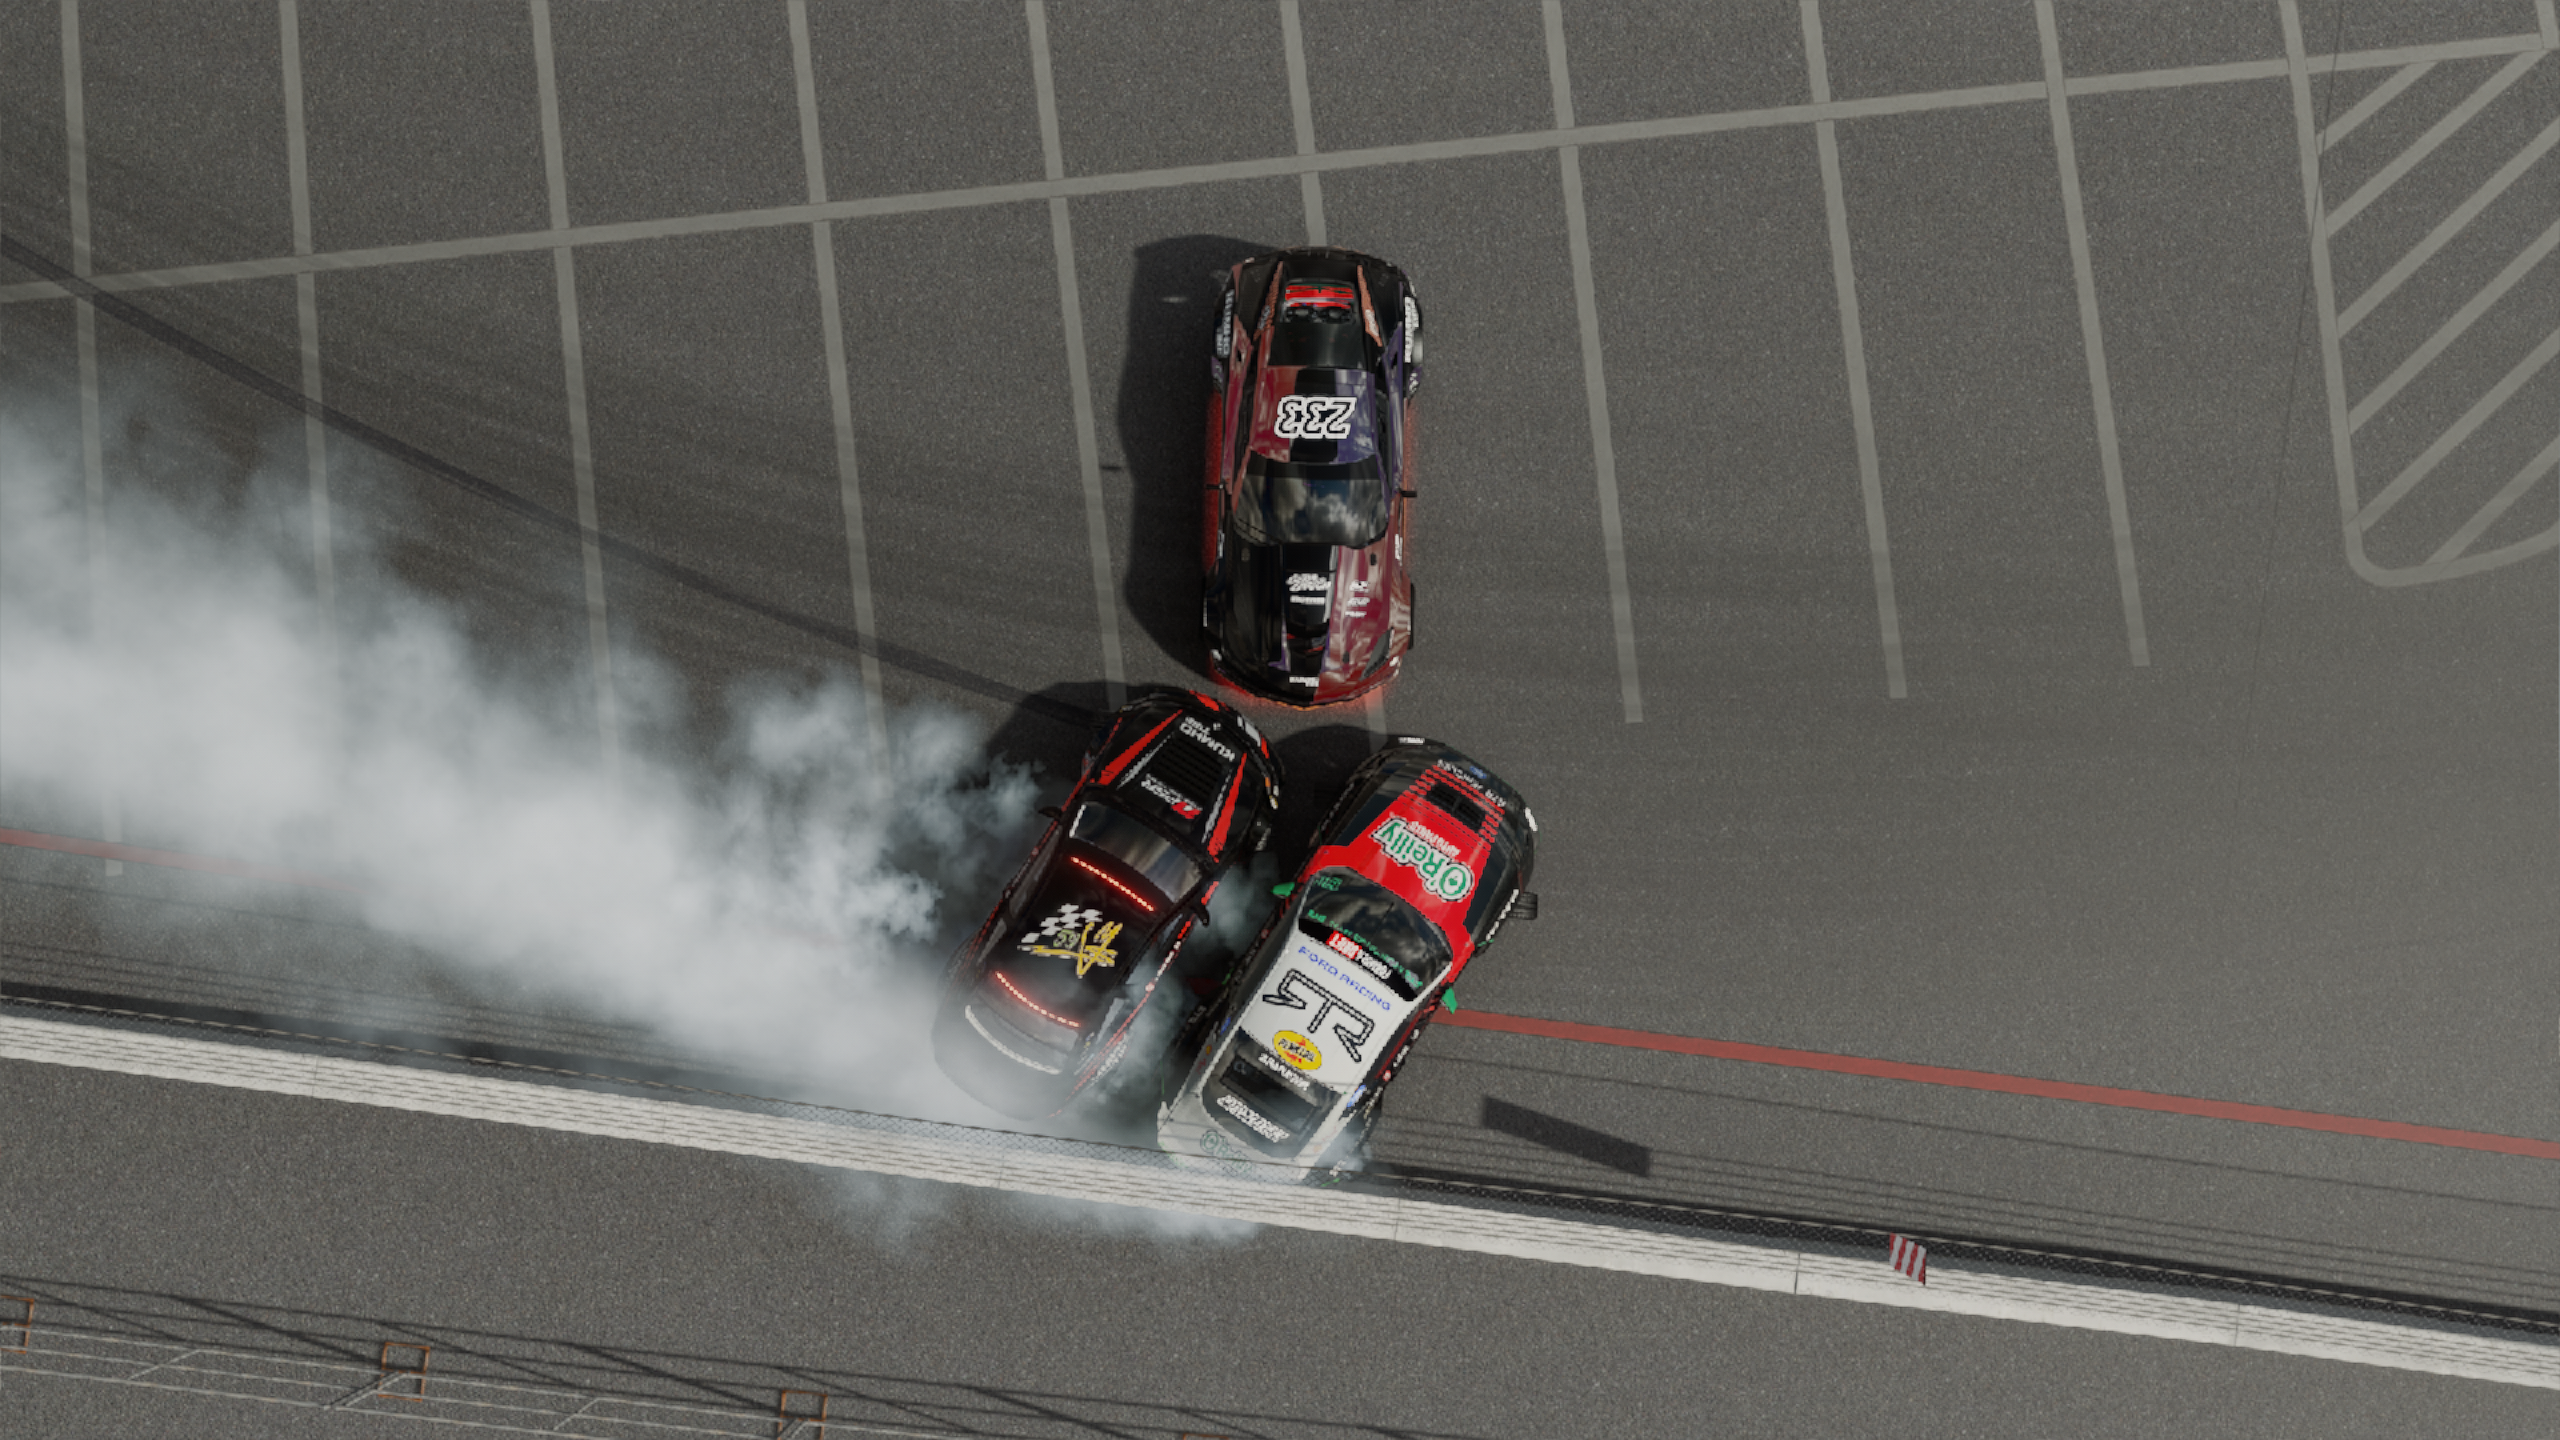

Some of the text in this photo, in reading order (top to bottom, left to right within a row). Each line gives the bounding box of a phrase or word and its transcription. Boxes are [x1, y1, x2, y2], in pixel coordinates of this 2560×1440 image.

[1275, 395, 1356, 439] 233
[1179, 721, 1235, 762] KUMHO
[1377, 820, 1469, 898] O'Reilly
[1297, 945, 1338, 976] FORD
[1338, 973, 1391, 1011] RACING
